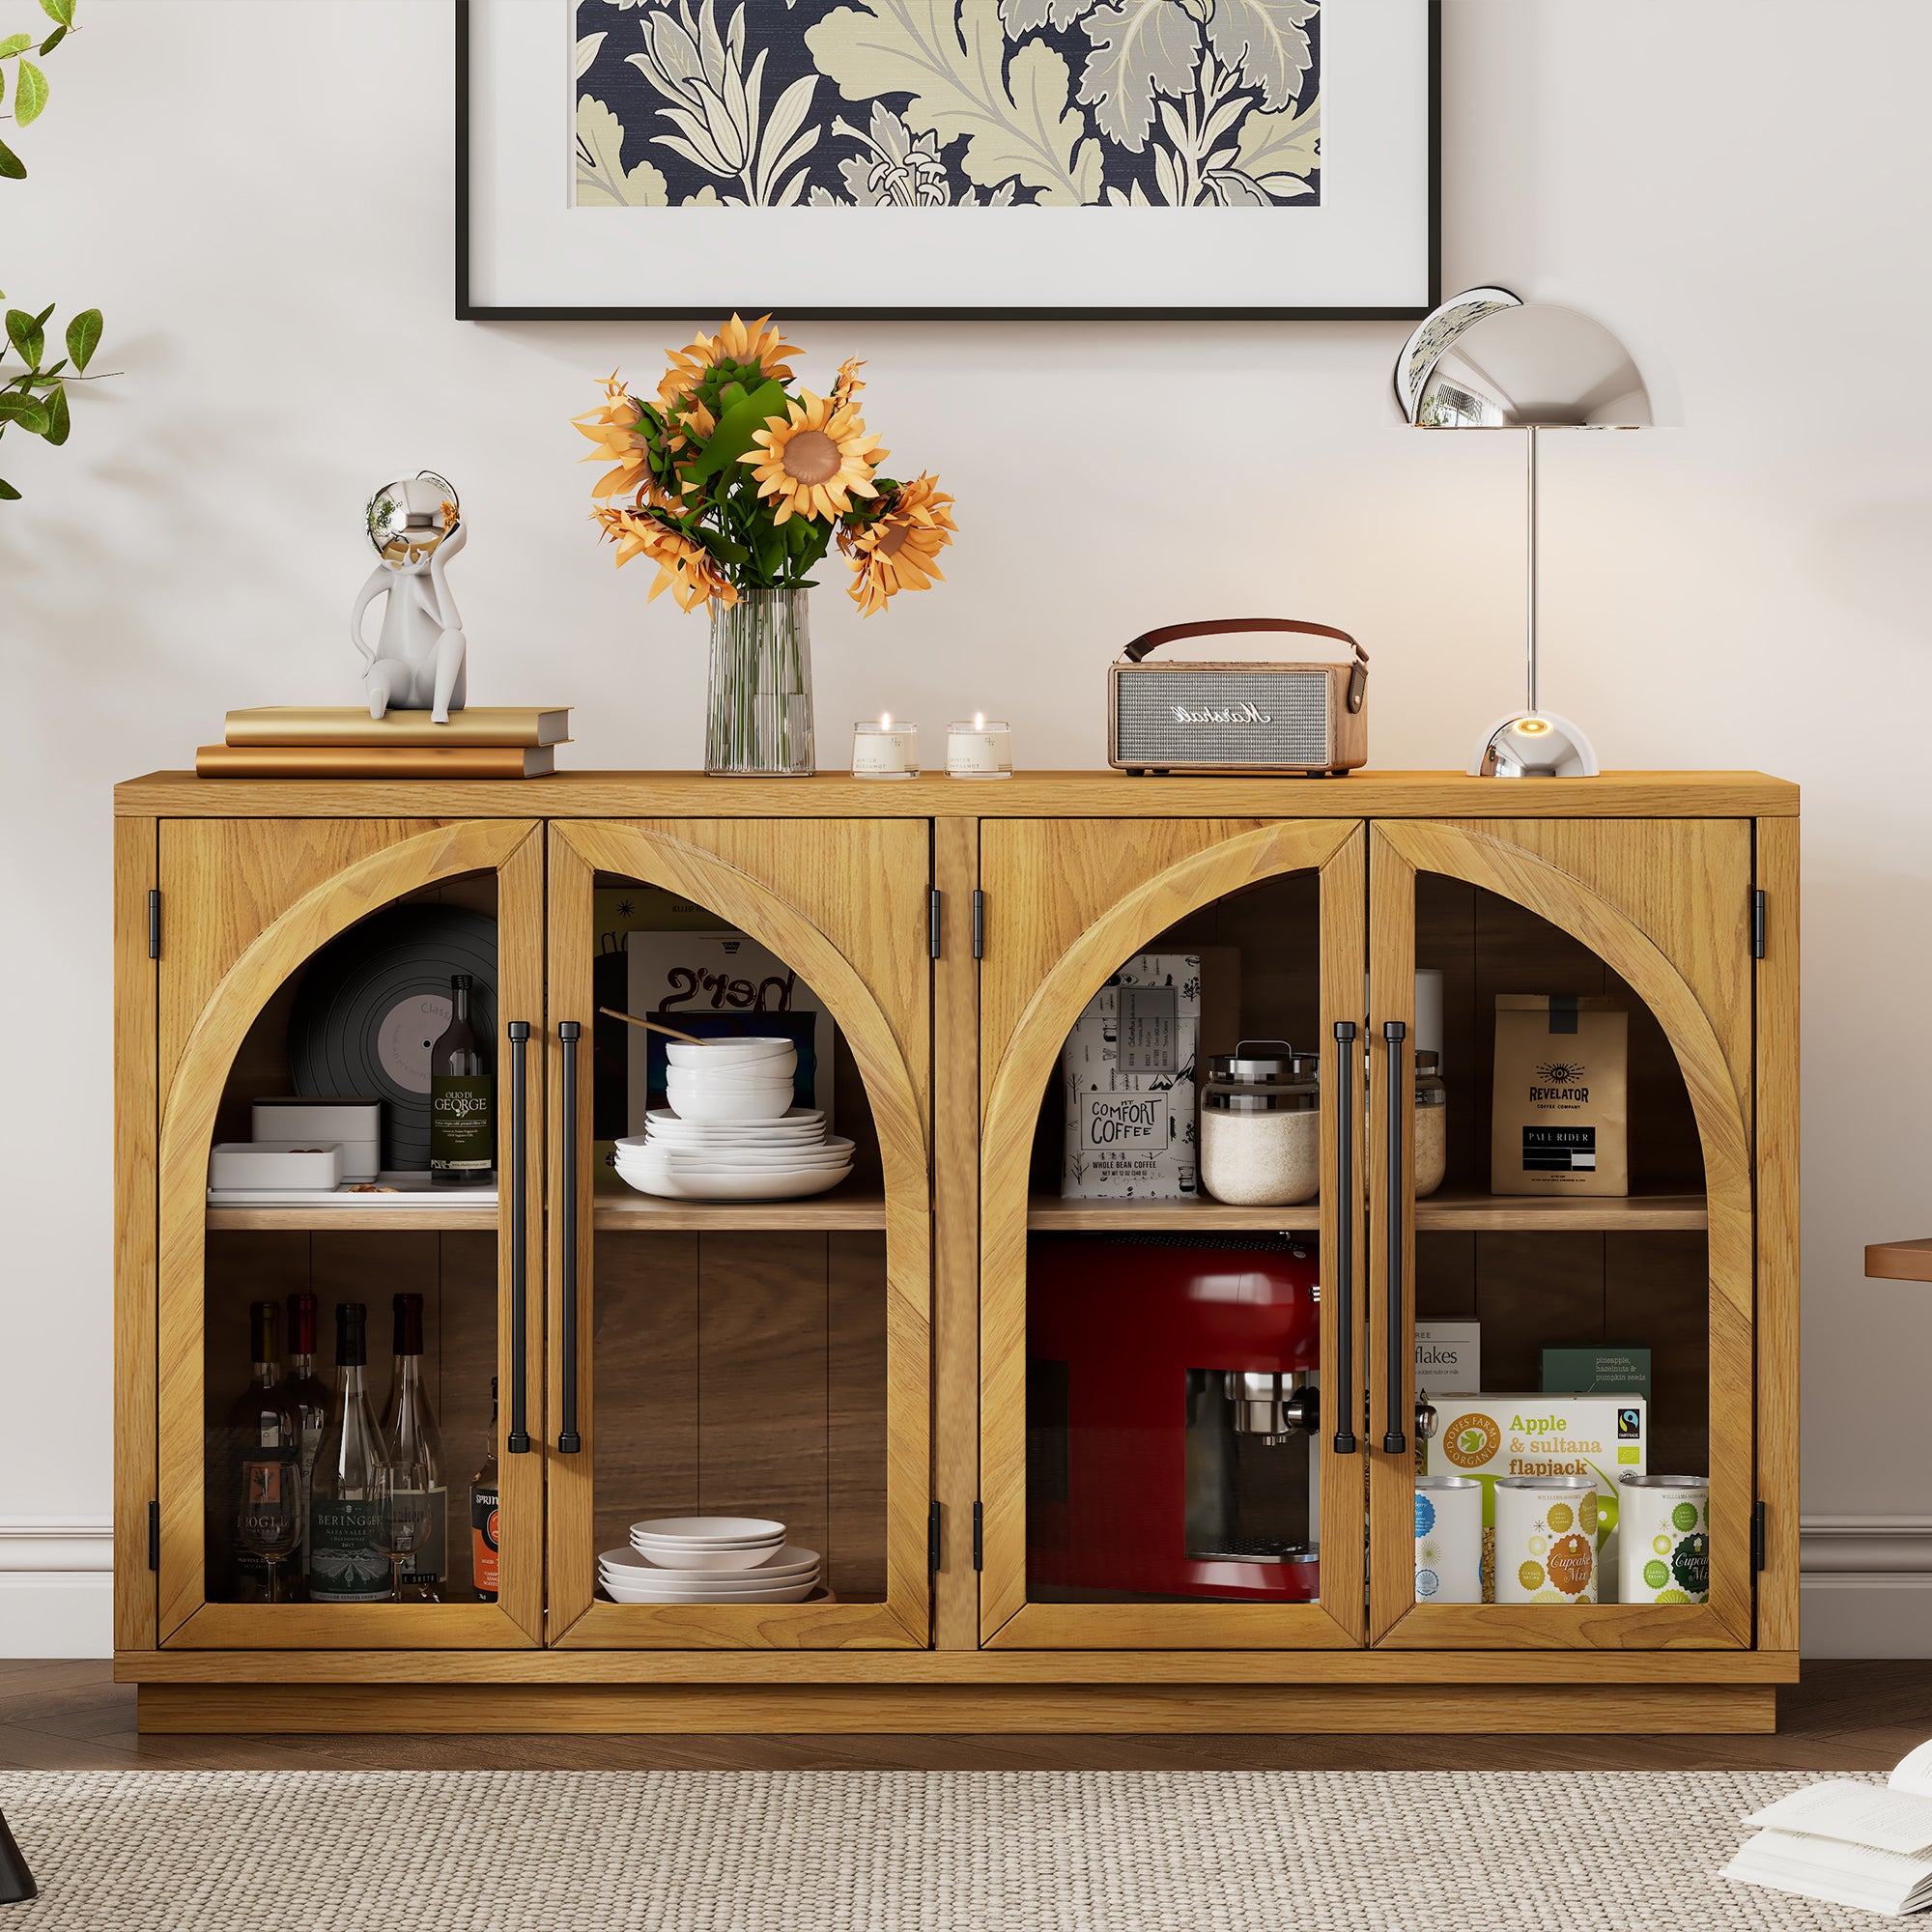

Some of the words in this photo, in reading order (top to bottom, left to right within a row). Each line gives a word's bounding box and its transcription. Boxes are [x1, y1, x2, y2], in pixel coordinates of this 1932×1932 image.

[1529, 1086, 1589, 1103] REVELATOR
[434, 1097, 488, 1111] GEORGE
[1092, 1099, 1162, 1125] COMFORT
[1092, 1117, 1152, 1144] COFFEE
[1528, 1132, 1553, 1142] PALE
[1556, 1132, 1589, 1142] RIDER
[1415, 1346, 1458, 1364] flakes
[1596, 1356, 1631, 1365] pineapple,
[1596, 1374, 1626, 1382] pumpkin
[1447, 1417, 1469, 1449] DOVES
[1472, 1416, 1497, 1437] FARM
[1509, 1415, 1567, 1435] Apple
[1452, 1442, 1497, 1465] ORGANIC
[1509, 1436, 1524, 1454] &
[1529, 1436, 1602, 1453] sultana
[1509, 1459, 1587, 1477] flapjack
[475, 1494, 498, 1506] SPRIN
[1550, 1553, 1591, 1570] Cupcake
[1675, 1551, 1708, 1570] Cupca
[1563, 1566, 1588, 1583] Mix
[1689, 1566, 1708, 1581] Mi
